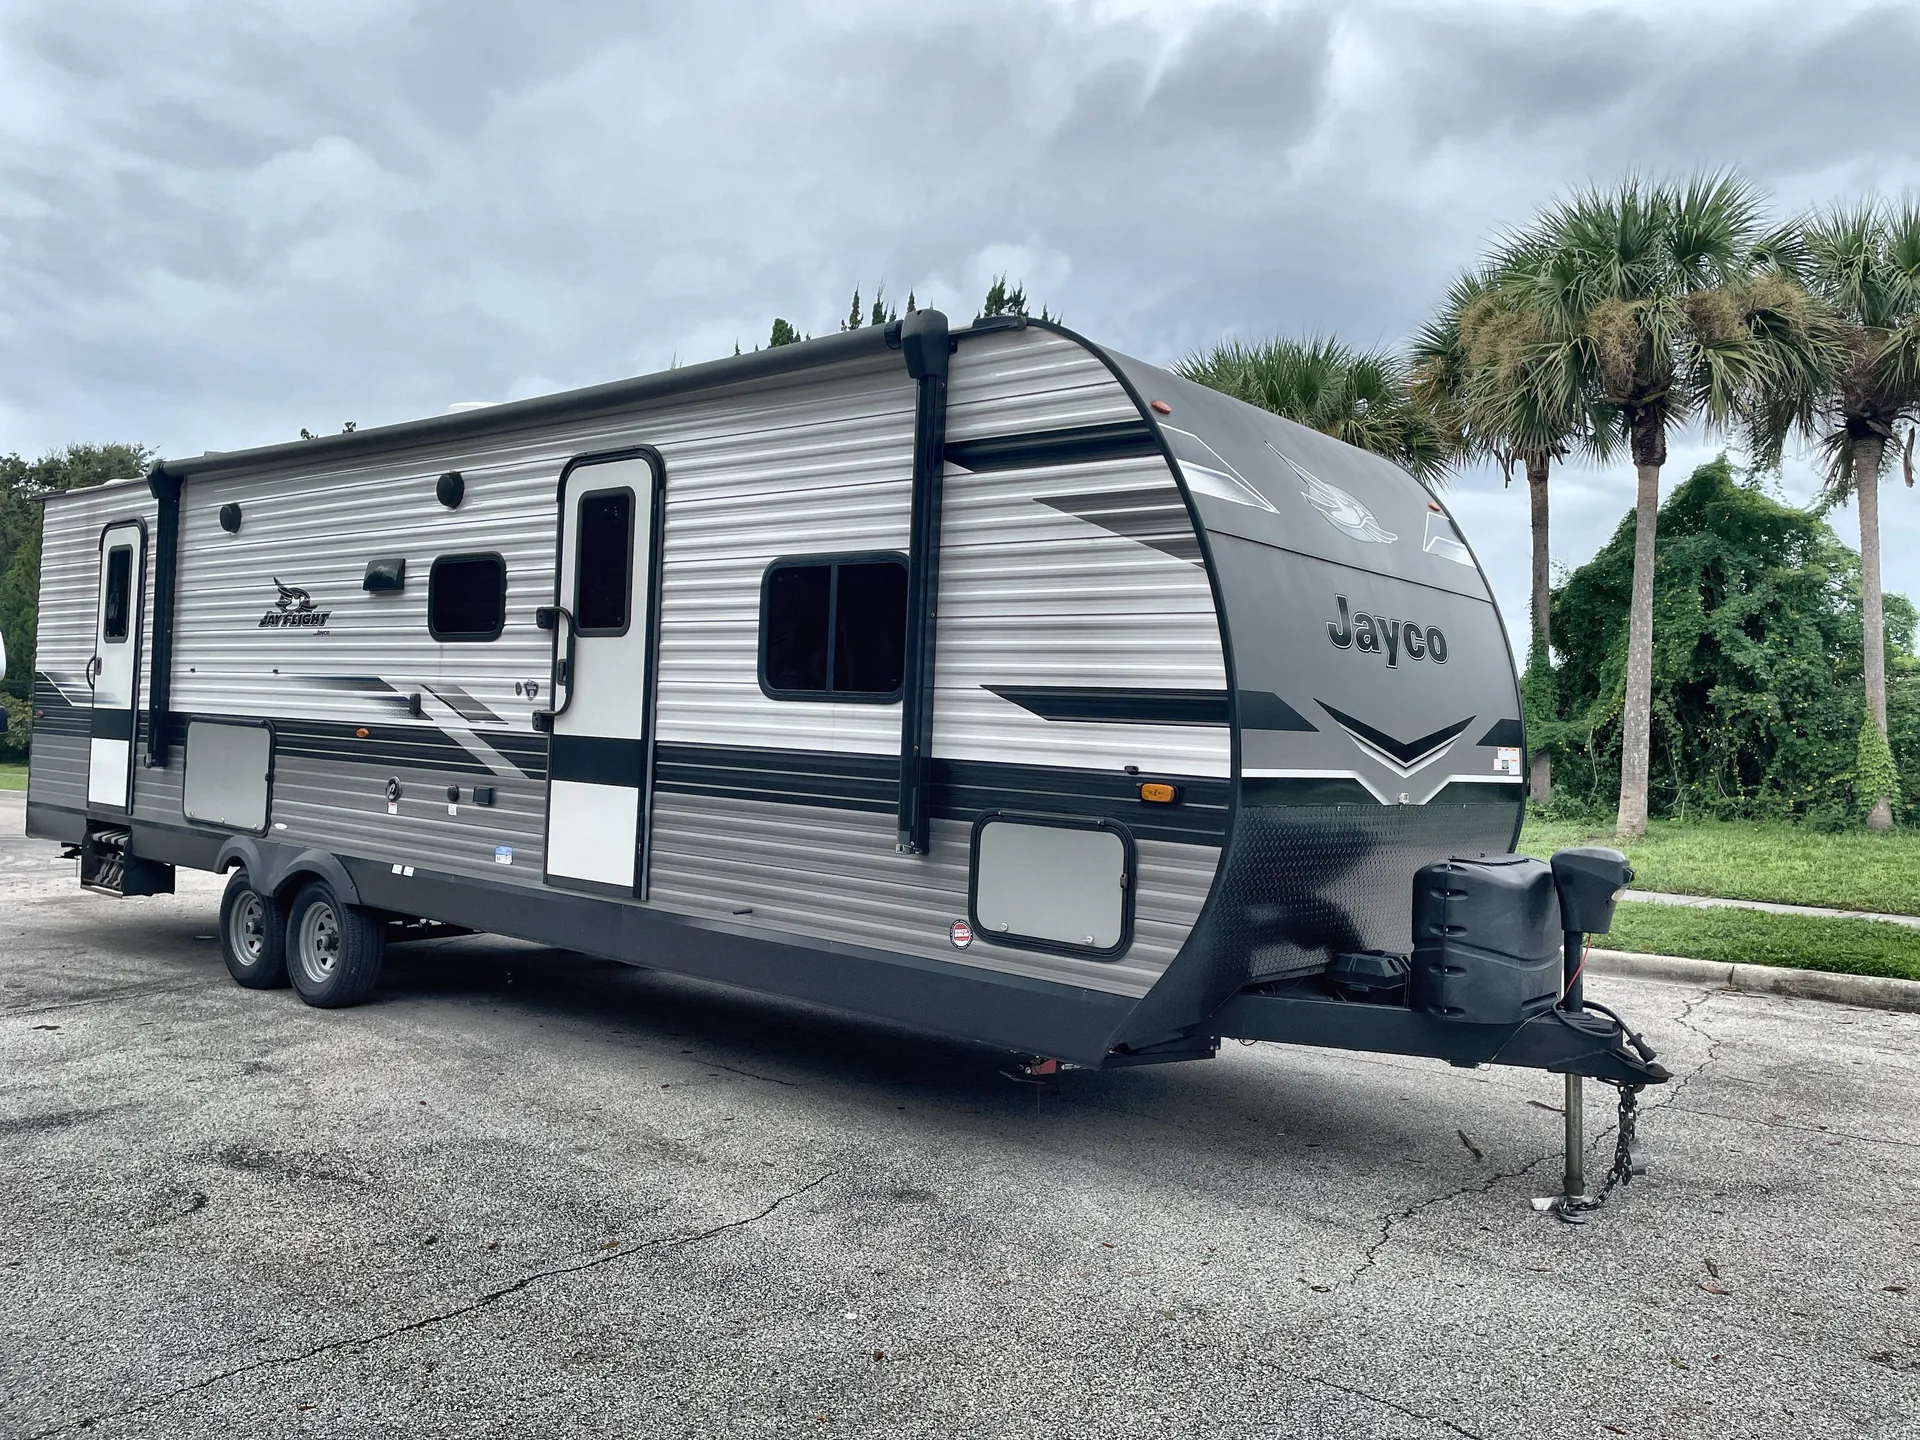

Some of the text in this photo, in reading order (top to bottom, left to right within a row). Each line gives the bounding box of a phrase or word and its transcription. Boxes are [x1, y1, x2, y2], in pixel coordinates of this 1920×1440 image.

[258, 611, 332, 627] JAY FLIGHT
[1325, 593, 1449, 669] Jayco
